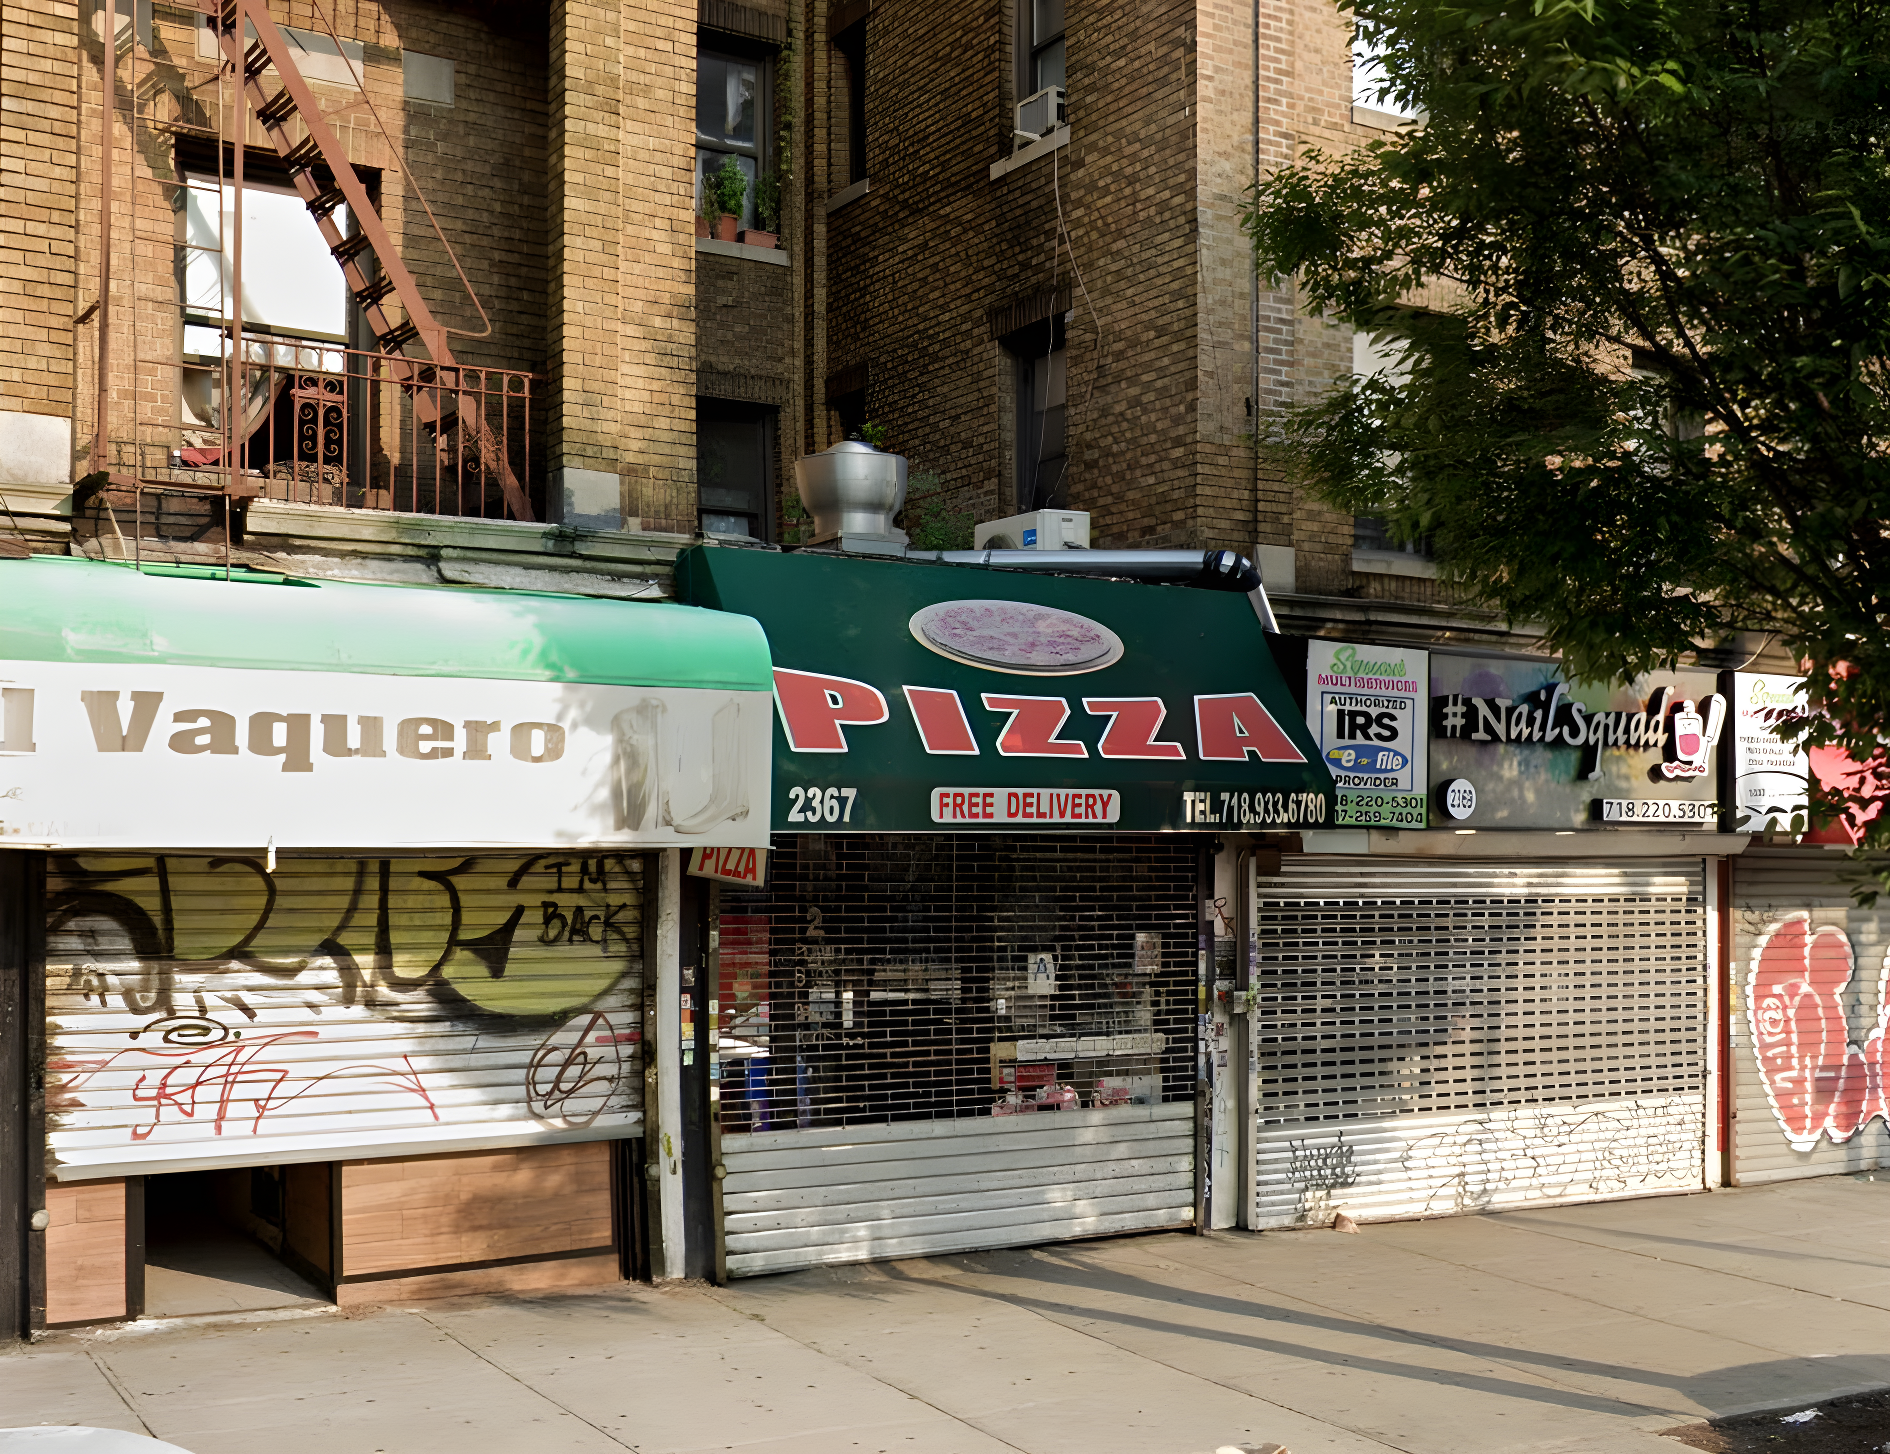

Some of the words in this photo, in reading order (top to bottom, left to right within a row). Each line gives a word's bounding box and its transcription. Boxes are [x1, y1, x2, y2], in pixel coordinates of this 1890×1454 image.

[81, 690, 566, 772] Vaquero
[772, 667, 1308, 763] PIZZA
[1336, 708, 1399, 742] IRS
[787, 786, 857, 823] 2367
[938, 792, 995, 819] FREE
[1006, 792, 1113, 819] DELIVERY
[697, 847, 757, 881] PIZZA
[538, 901, 632, 951] BACK
